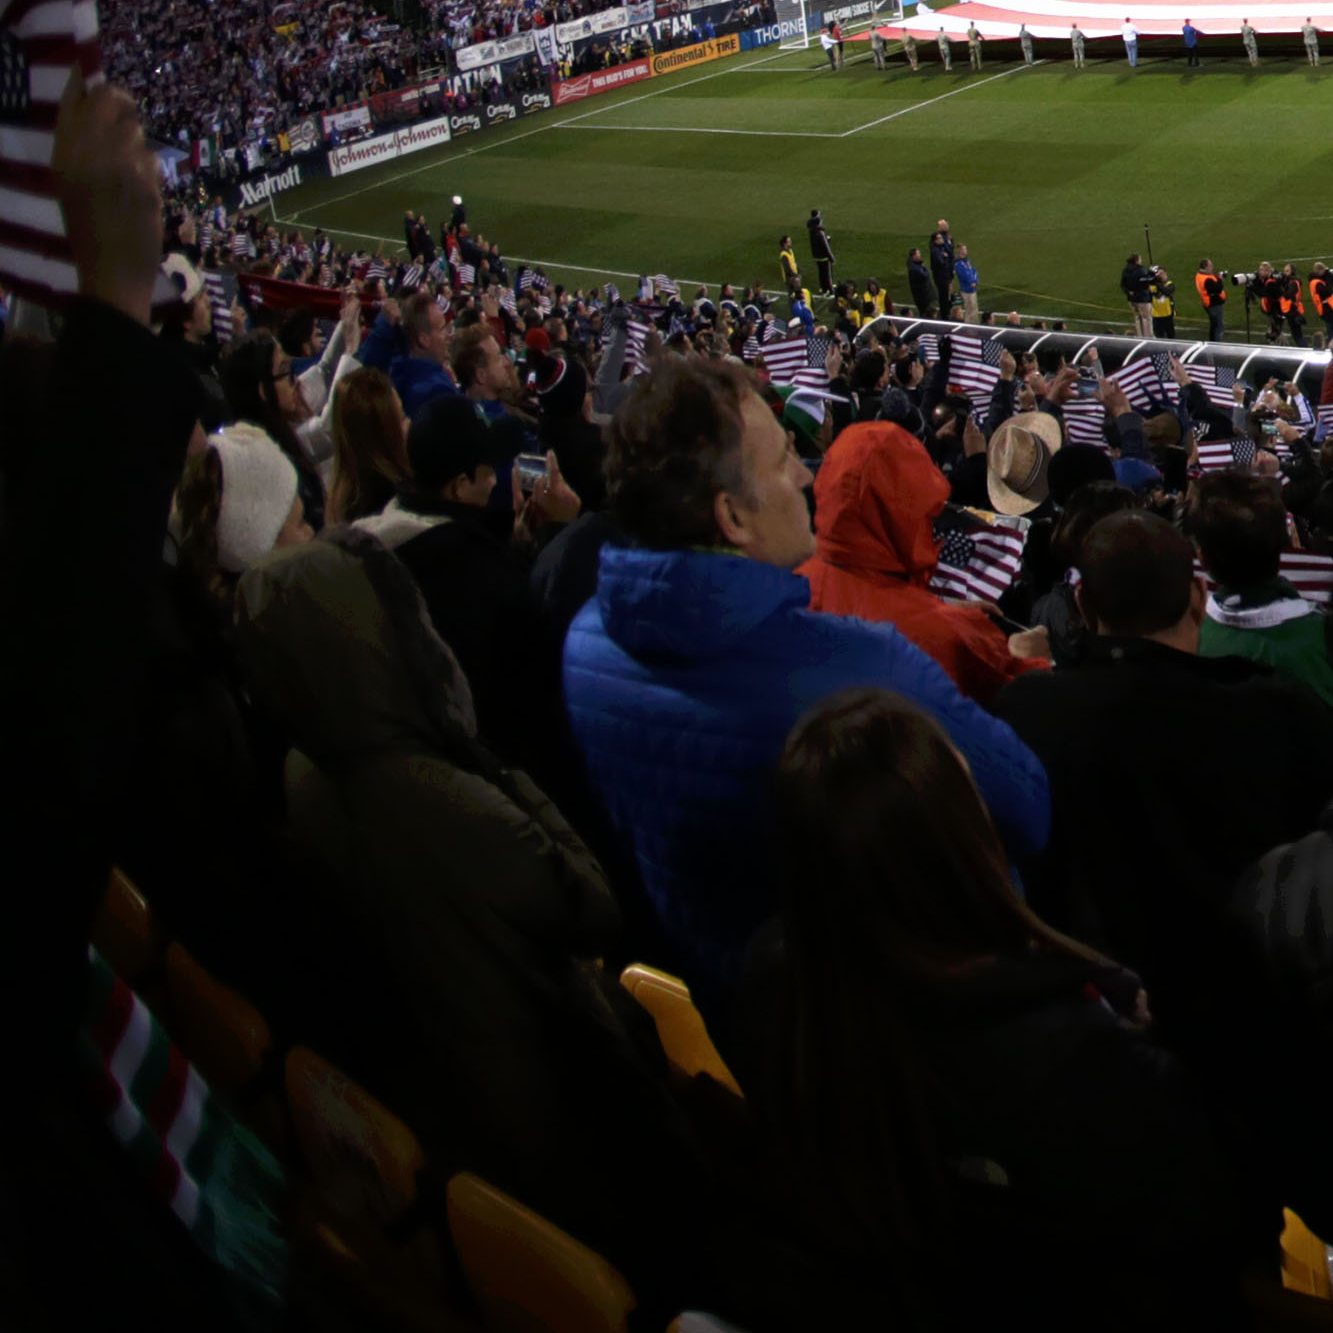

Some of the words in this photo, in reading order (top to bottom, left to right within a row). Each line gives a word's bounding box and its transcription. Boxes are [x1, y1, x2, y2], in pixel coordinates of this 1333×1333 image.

[754, 18, 805, 44] THORNE
[653, 44, 707, 74] Continental
[716, 37, 737, 52] TIRE
[332, 139, 388, 173] Johnson
[393, 122, 447, 156] Johnson
[238, 164, 301, 210] Marriott
